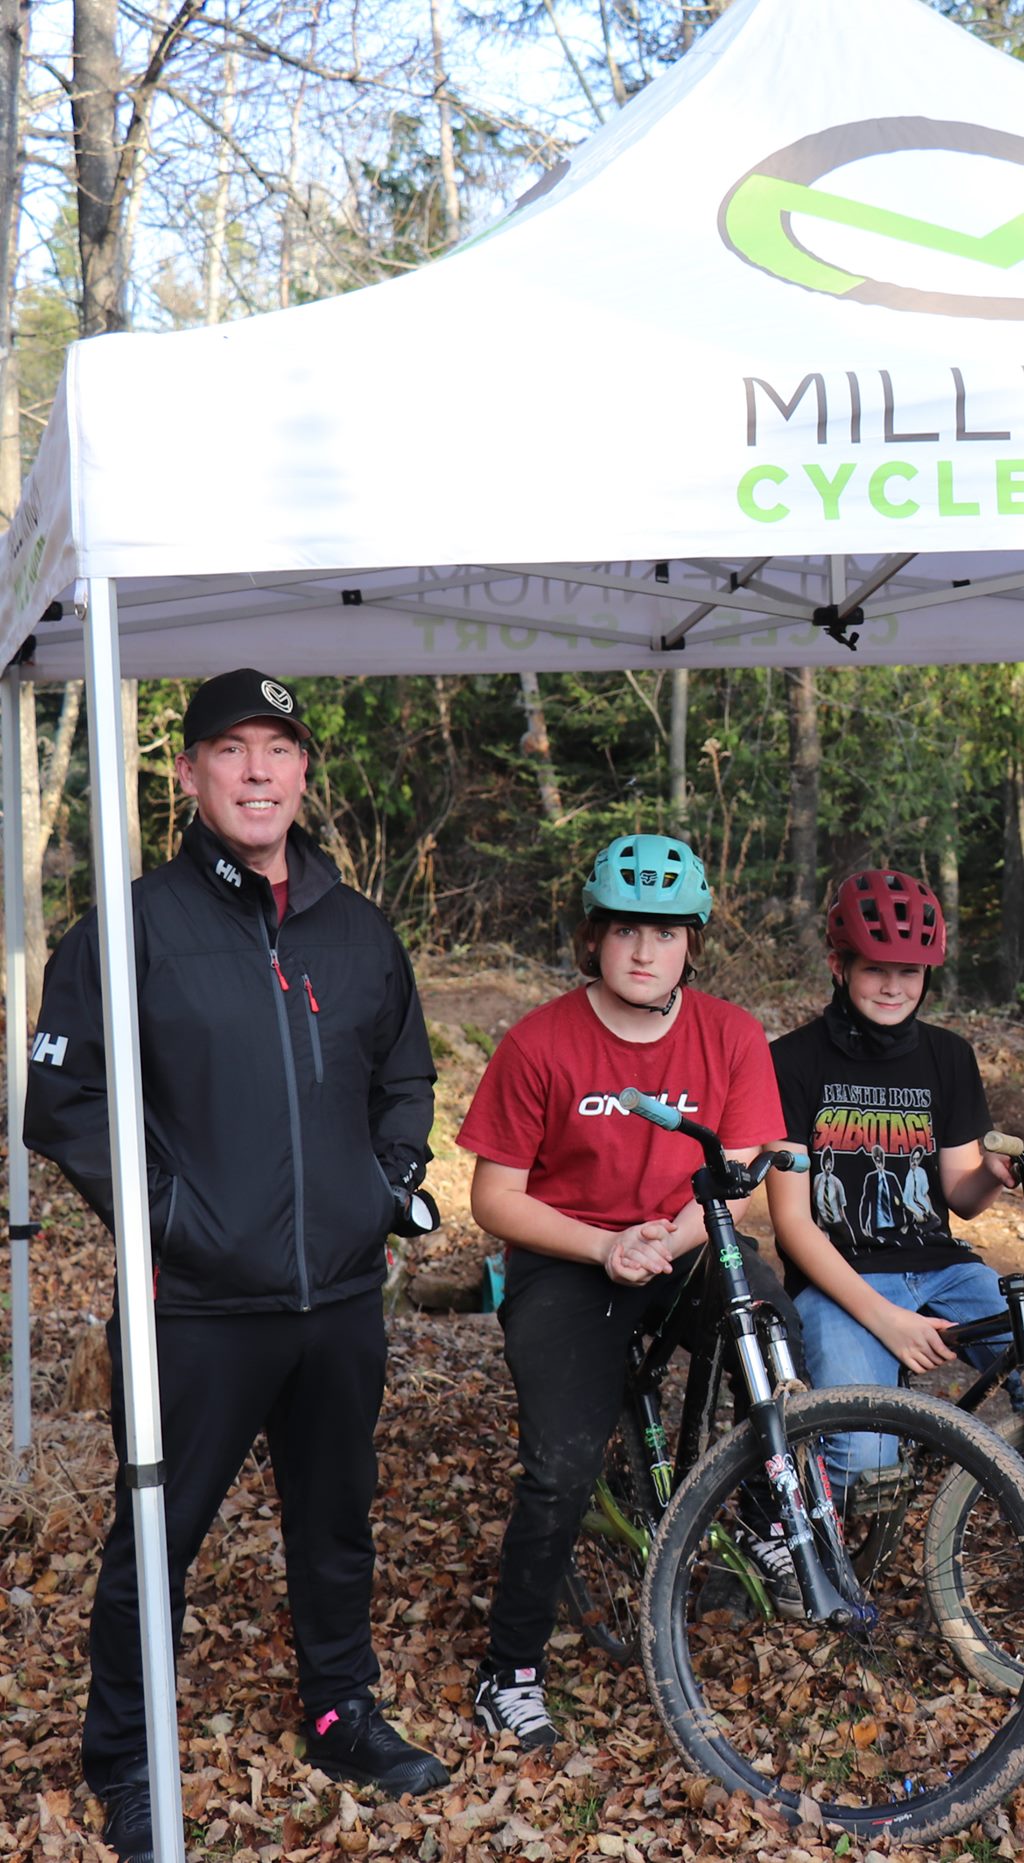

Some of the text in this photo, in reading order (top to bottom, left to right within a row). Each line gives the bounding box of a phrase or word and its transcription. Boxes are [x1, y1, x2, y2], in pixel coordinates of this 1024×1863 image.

[215, 858, 242, 888] HH
[578, 1090, 699, 1116] O'NLL
[823, 1084, 932, 1107] BEASTIE BOYS
[812, 1107, 937, 1157] SABOTAGE
